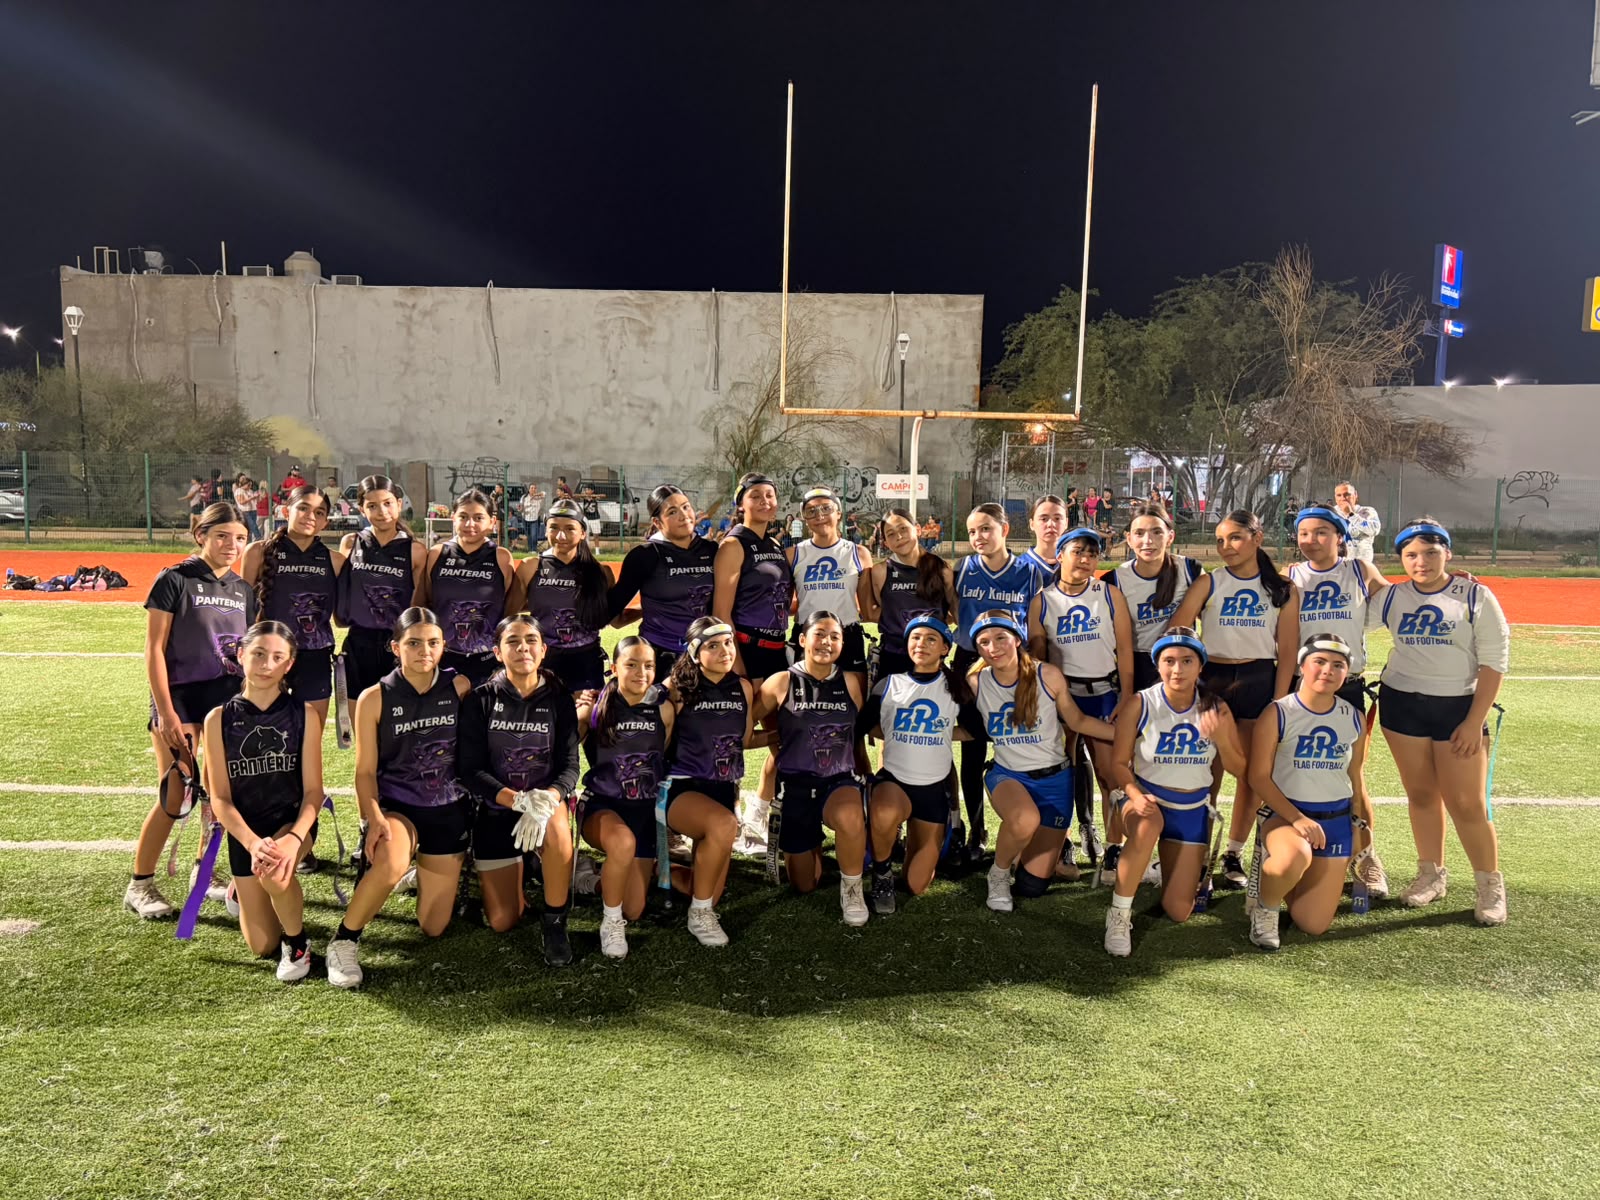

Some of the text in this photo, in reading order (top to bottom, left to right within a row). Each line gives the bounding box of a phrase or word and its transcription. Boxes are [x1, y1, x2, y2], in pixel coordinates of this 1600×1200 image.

[881, 482, 925, 491] CAMP 3
[277, 552, 287, 560] 26
[445, 557, 455, 566] 28
[277, 565, 326, 576] PANTERAS
[352, 562, 404, 578] PANTERAS
[439, 568, 493, 580] PANTERAS
[197, 583, 204, 593] 5
[538, 578, 576, 588] PANTER
[804, 582, 846, 592] FLAG FOOTBALL
[892, 583, 918, 591] PANT
[1091, 583, 1102, 592] 44
[962, 584, 1025, 604] Lady Knights
[1451, 585, 1464, 594] 21
[195, 595, 245, 612] PANTERAS
[1300, 610, 1352, 622] FLAG FOOTBALL
[1219, 618, 1266, 627] FLAG FOOTBALL
[1056, 633, 1101, 645] FLAG FOOTBALL
[1416, 637, 1455, 646] FOOTBALL
[795, 688, 804, 697] 25
[392, 706, 404, 716] 20
[493, 702, 504, 712] 48
[794, 702, 848, 712] PANTERAS
[1339, 705, 1349, 715] 11
[395, 714, 455, 735] PANTERAS
[490, 719, 549, 733] PANTERAS
[617, 721, 656, 732] NTERAS
[891, 732, 944, 746] FLAG FOOTBALL
[1007, 735, 1043, 745] FOOTBALL
[1153, 757, 1209, 765] FLAG FOOTBALL
[1293, 760, 1344, 770] FLAG FOOTBALL
[1054, 816, 1065, 827] 12
[1331, 844, 1342, 854] 11
[1248, 851, 1262, 898] SONORA
